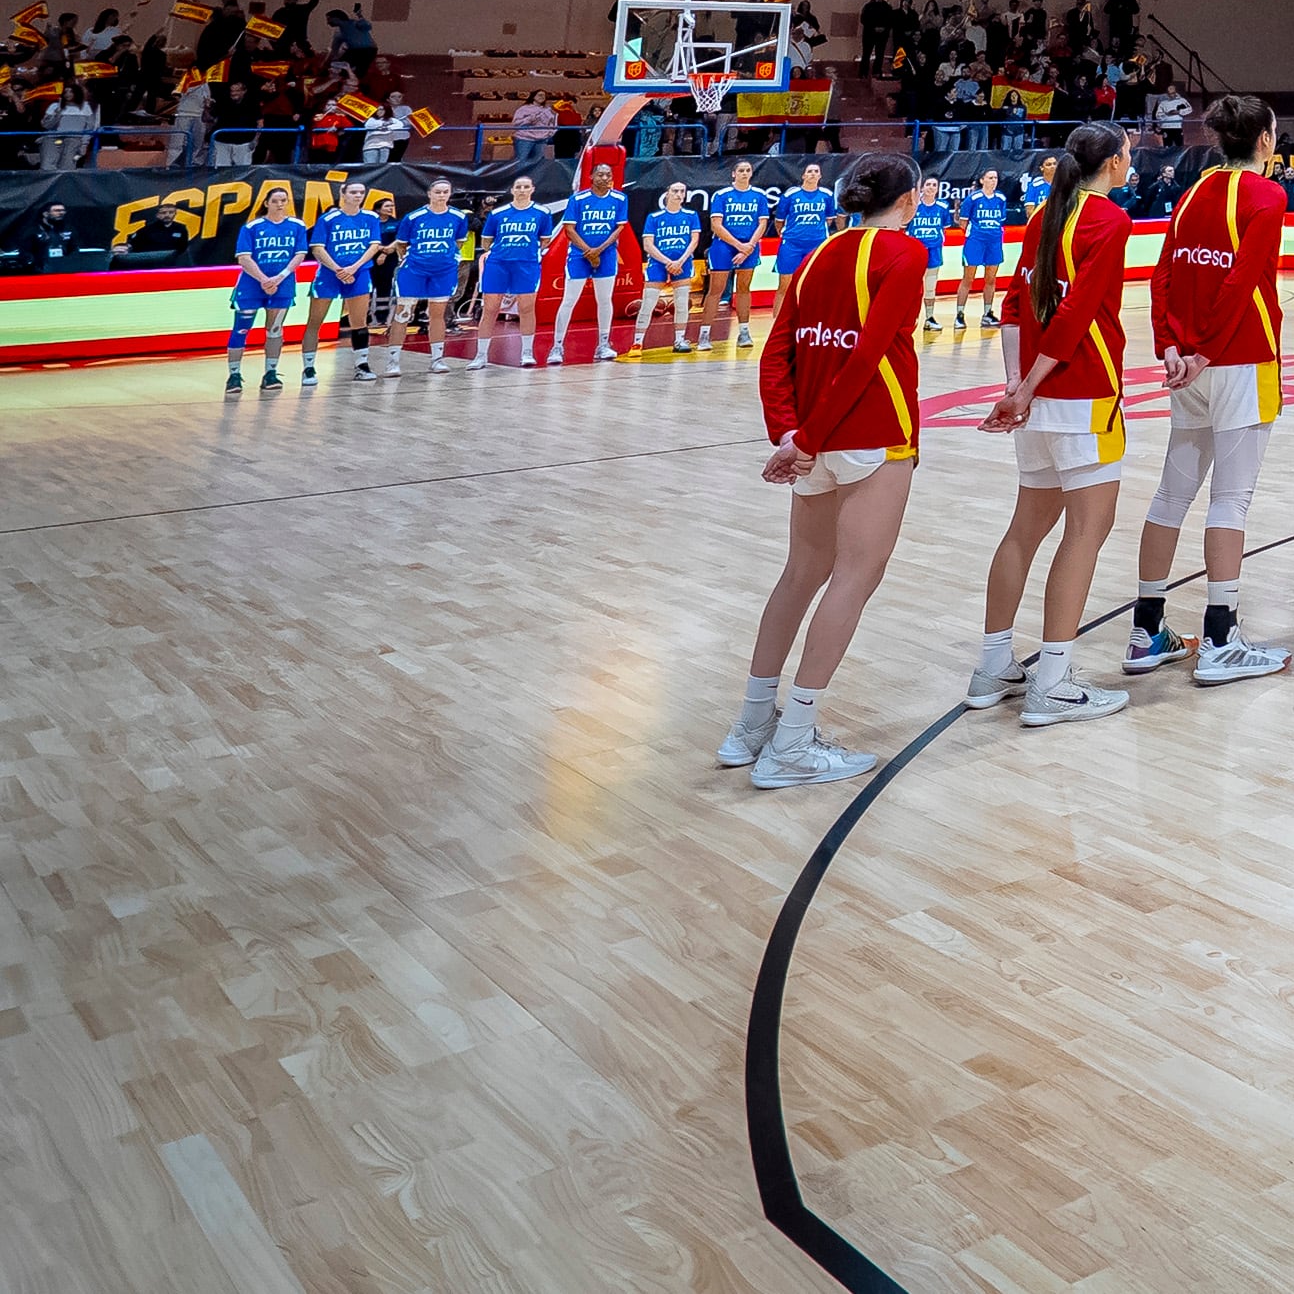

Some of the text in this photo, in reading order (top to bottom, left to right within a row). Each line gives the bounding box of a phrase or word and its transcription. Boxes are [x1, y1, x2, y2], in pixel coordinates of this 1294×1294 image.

[725, 203, 758, 213] ITALIA
[794, 202, 826, 212] ITALIA
[582, 210, 616, 221] ITALIA
[976, 209, 1001, 219] ITALIA
[913, 217, 941, 226] ITALIA
[417, 227, 453, 239] ITALIA
[500, 222, 536, 233] ITALIA
[657, 225, 690, 237] ITALIA
[331, 229, 370, 242] ITALIA
[255, 236, 295, 249] ITALIA
